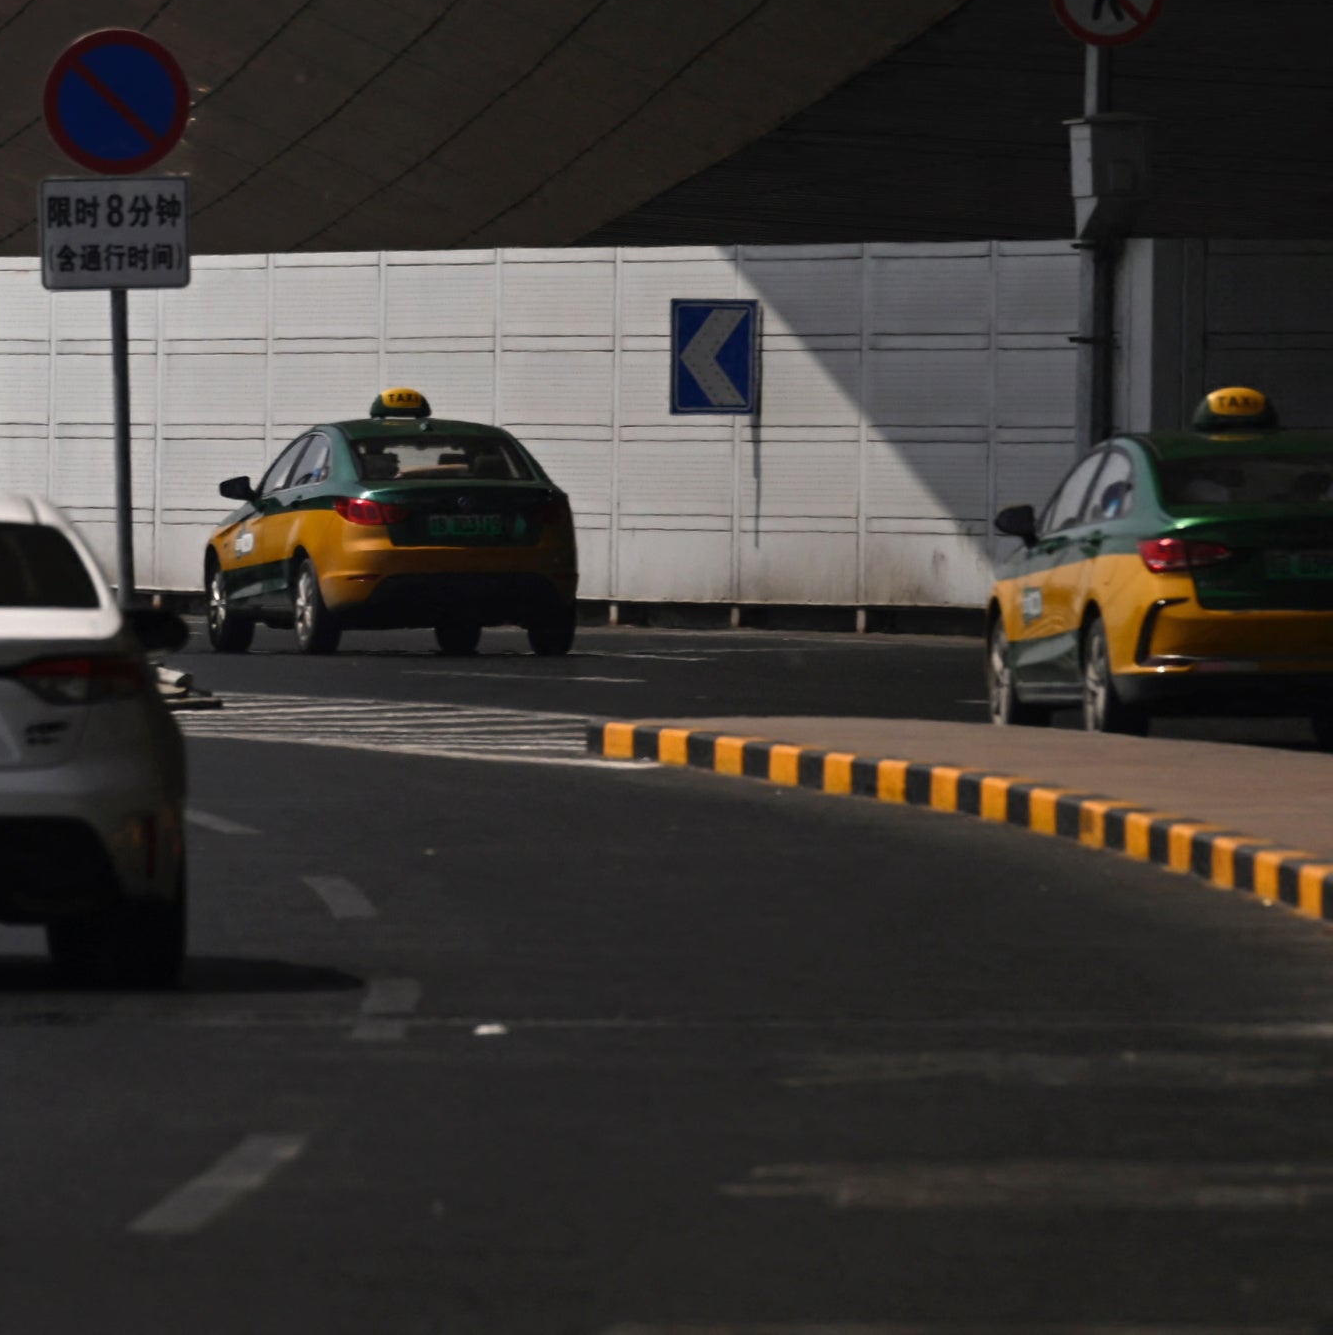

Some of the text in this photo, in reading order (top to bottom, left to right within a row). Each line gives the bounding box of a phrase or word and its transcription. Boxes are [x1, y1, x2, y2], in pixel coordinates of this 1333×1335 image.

[47, 193, 182, 229] 限时8分钟
[388, 392, 421, 403] TAXI
